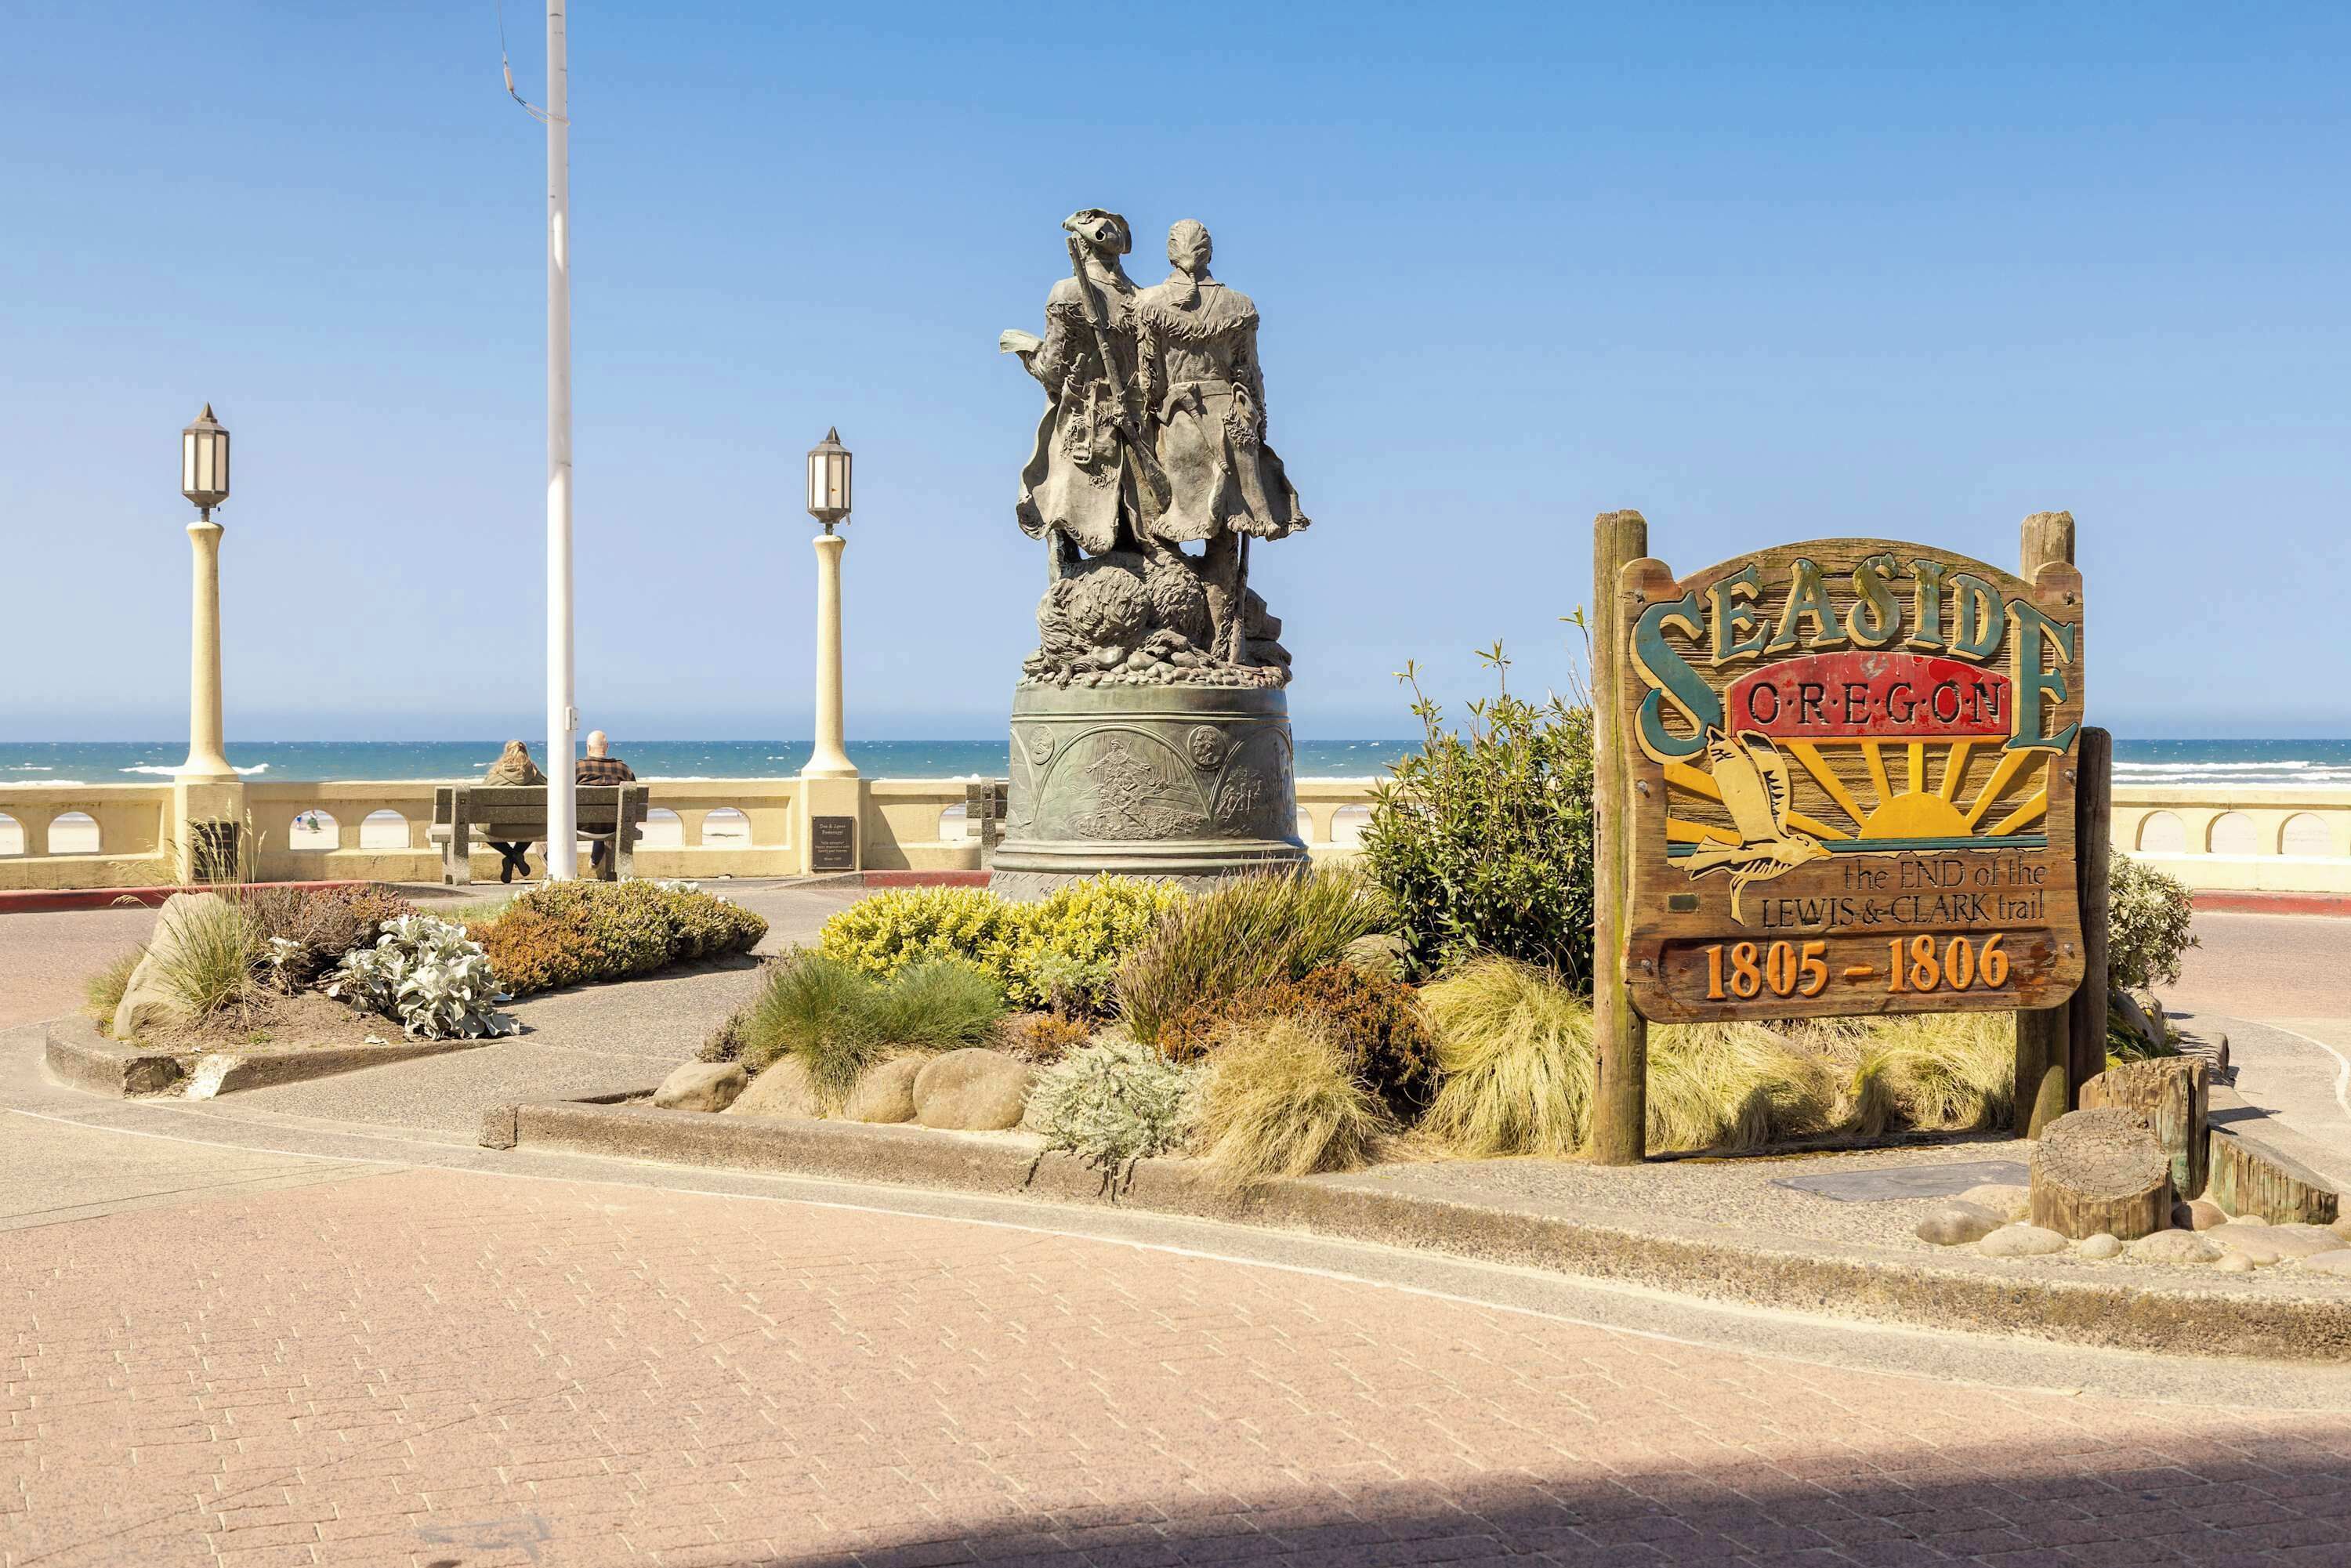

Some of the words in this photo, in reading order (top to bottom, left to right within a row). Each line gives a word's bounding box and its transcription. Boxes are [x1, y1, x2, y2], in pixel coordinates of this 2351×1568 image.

[1629, 552, 2080, 765] SEASIDE
[1843, 859, 1889, 890] the
[1900, 859, 1966, 889] END
[1975, 856, 2001, 887] of
[2008, 857, 2049, 887] the
[1761, 896, 1855, 929] LEWIS
[1861, 898, 1882, 926] &
[1889, 893, 1991, 925] CLARK
[1998, 889, 2046, 922] trail
[1705, 940, 1828, 1000] 1805
[1887, 933, 2010, 994] 1806
